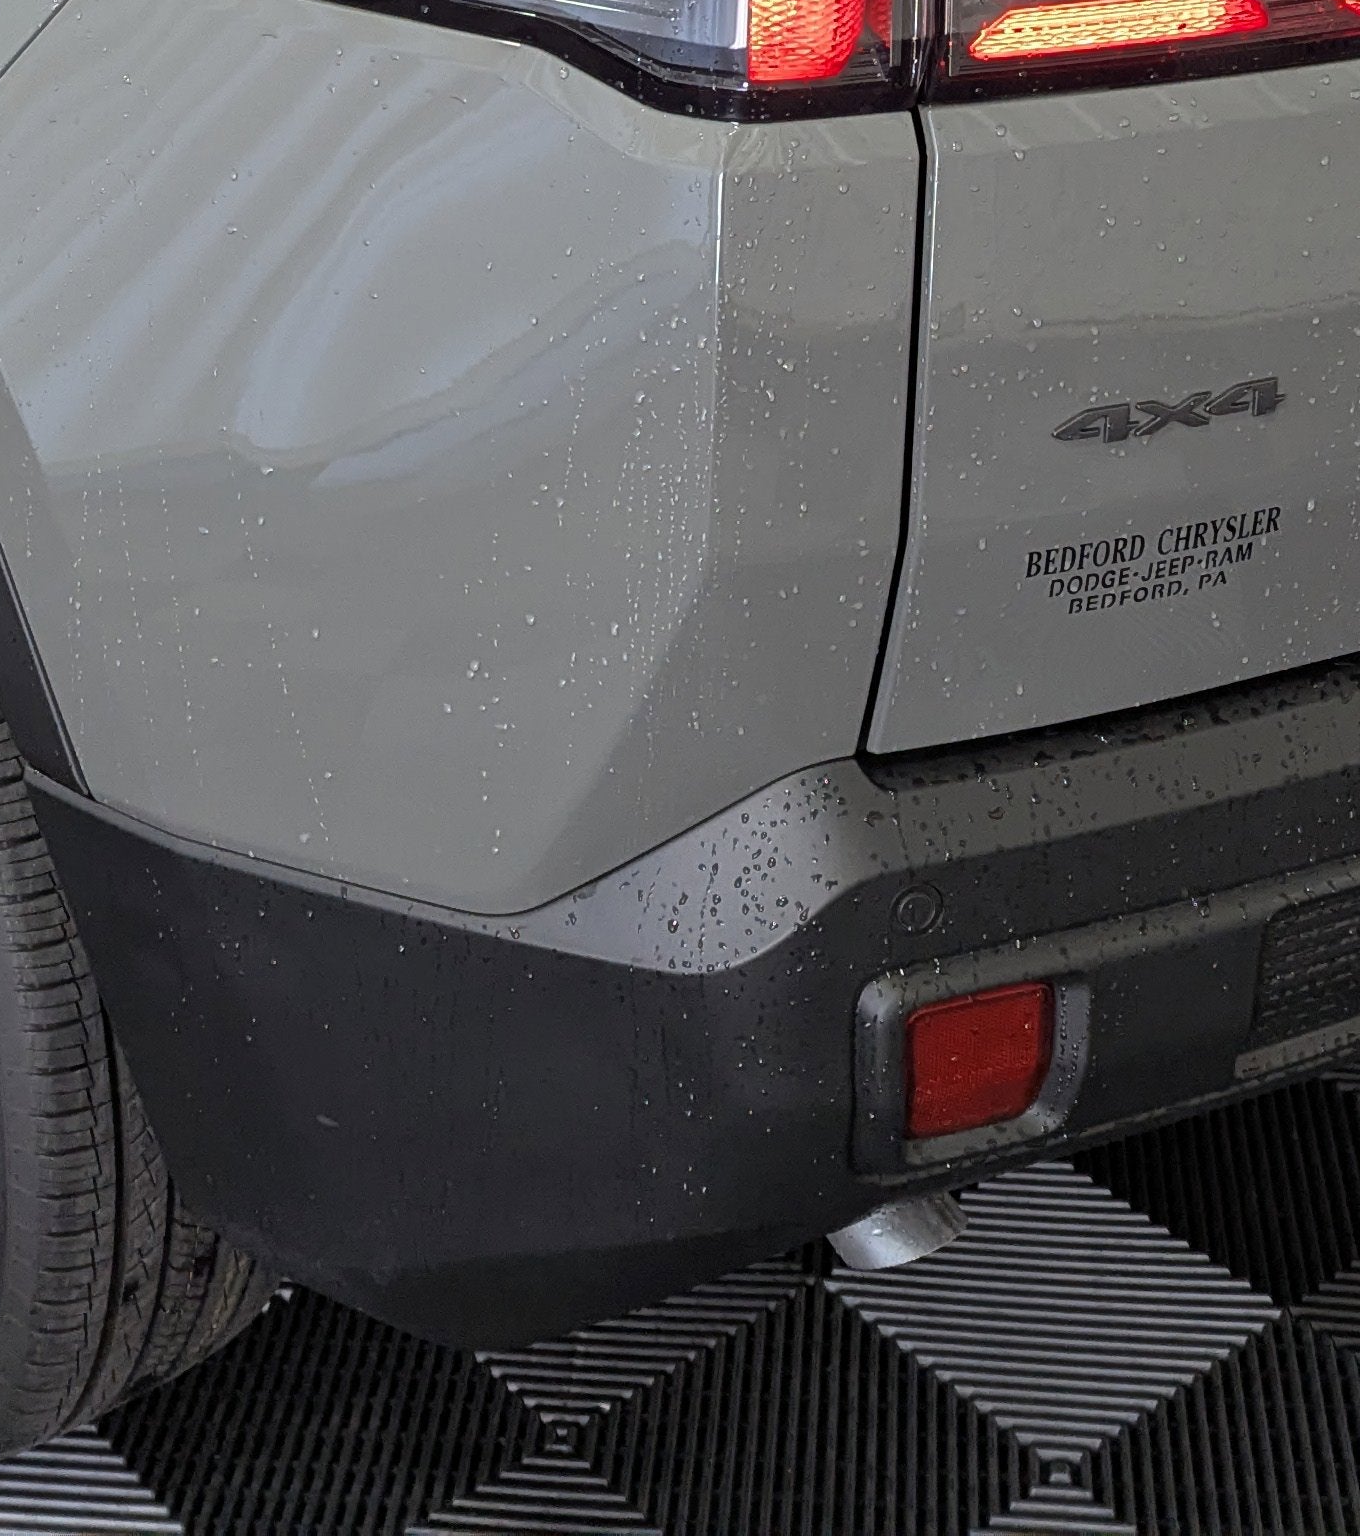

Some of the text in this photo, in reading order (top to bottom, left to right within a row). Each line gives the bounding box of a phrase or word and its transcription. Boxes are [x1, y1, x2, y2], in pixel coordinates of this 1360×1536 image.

[1025, 506, 1282, 579] BEDFORD CHRYSLER
[1198, 569, 1228, 590] PA
